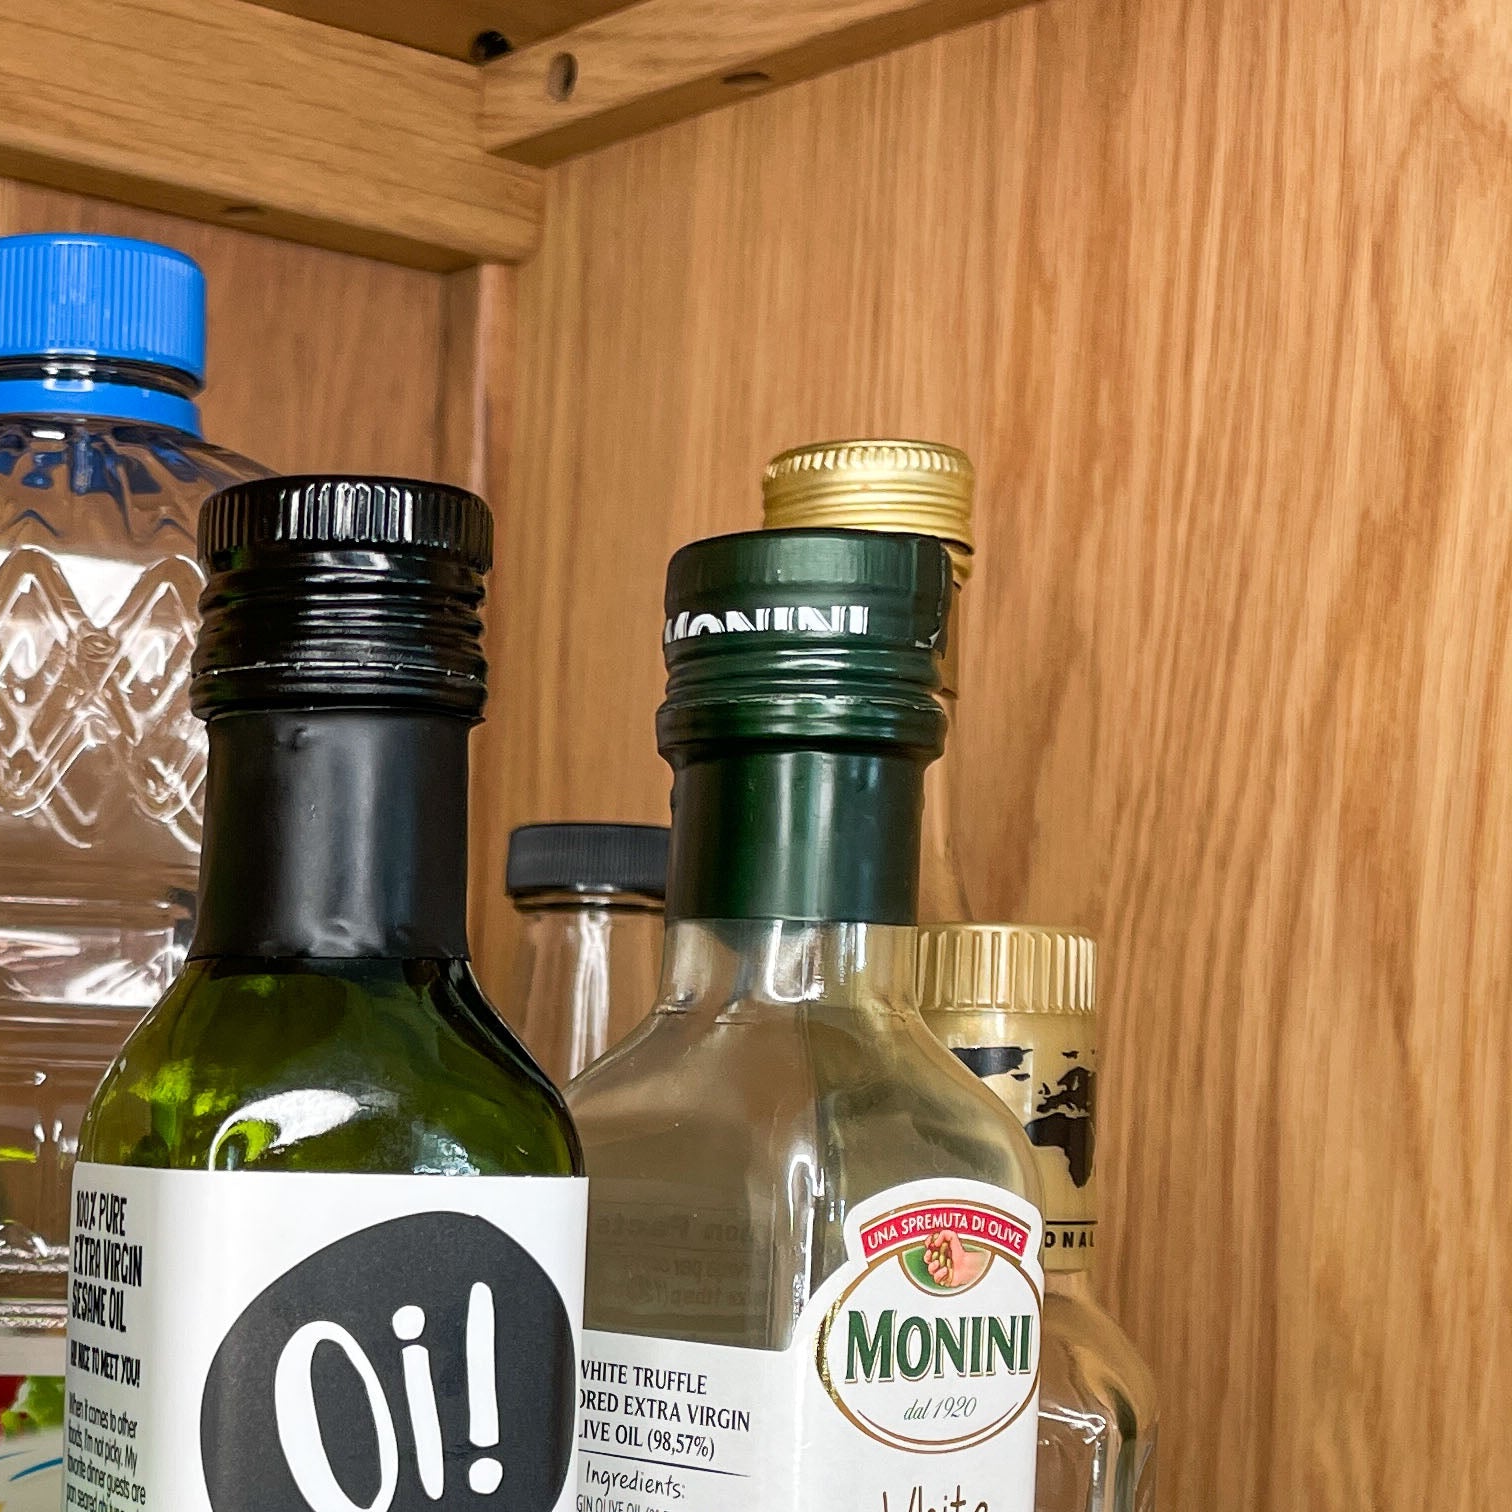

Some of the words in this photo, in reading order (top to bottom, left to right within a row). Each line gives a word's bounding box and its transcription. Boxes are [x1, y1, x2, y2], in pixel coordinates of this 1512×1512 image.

[76, 1189, 97, 1231] 100%
[99, 1192, 127, 1237] PURE
[868, 1223, 899, 1251] UNA
[899, 1209, 969, 1237] SPREMUTA
[970, 1212, 985, 1232] DI
[986, 1220, 1023, 1252] OLIVE
[73, 1233, 100, 1279] EXTRA
[103, 1239, 143, 1288] VIRGIN
[72, 1278, 107, 1328] SESAME
[108, 1286, 127, 1333] OIL
[844, 1309, 1034, 1384] MONINI
[634, 1366, 708, 1395] TRUFFLE
[624, 1396, 681, 1423] EXTRA
[687, 1403, 751, 1433] VIRGIN
[903, 1399, 928, 1422] dal
[930, 1397, 977, 1419] 1920
[615, 1424, 643, 1447] OIL
[647, 1428, 715, 1462] (98,57%)
[585, 1460, 686, 1500] Ingredients:
